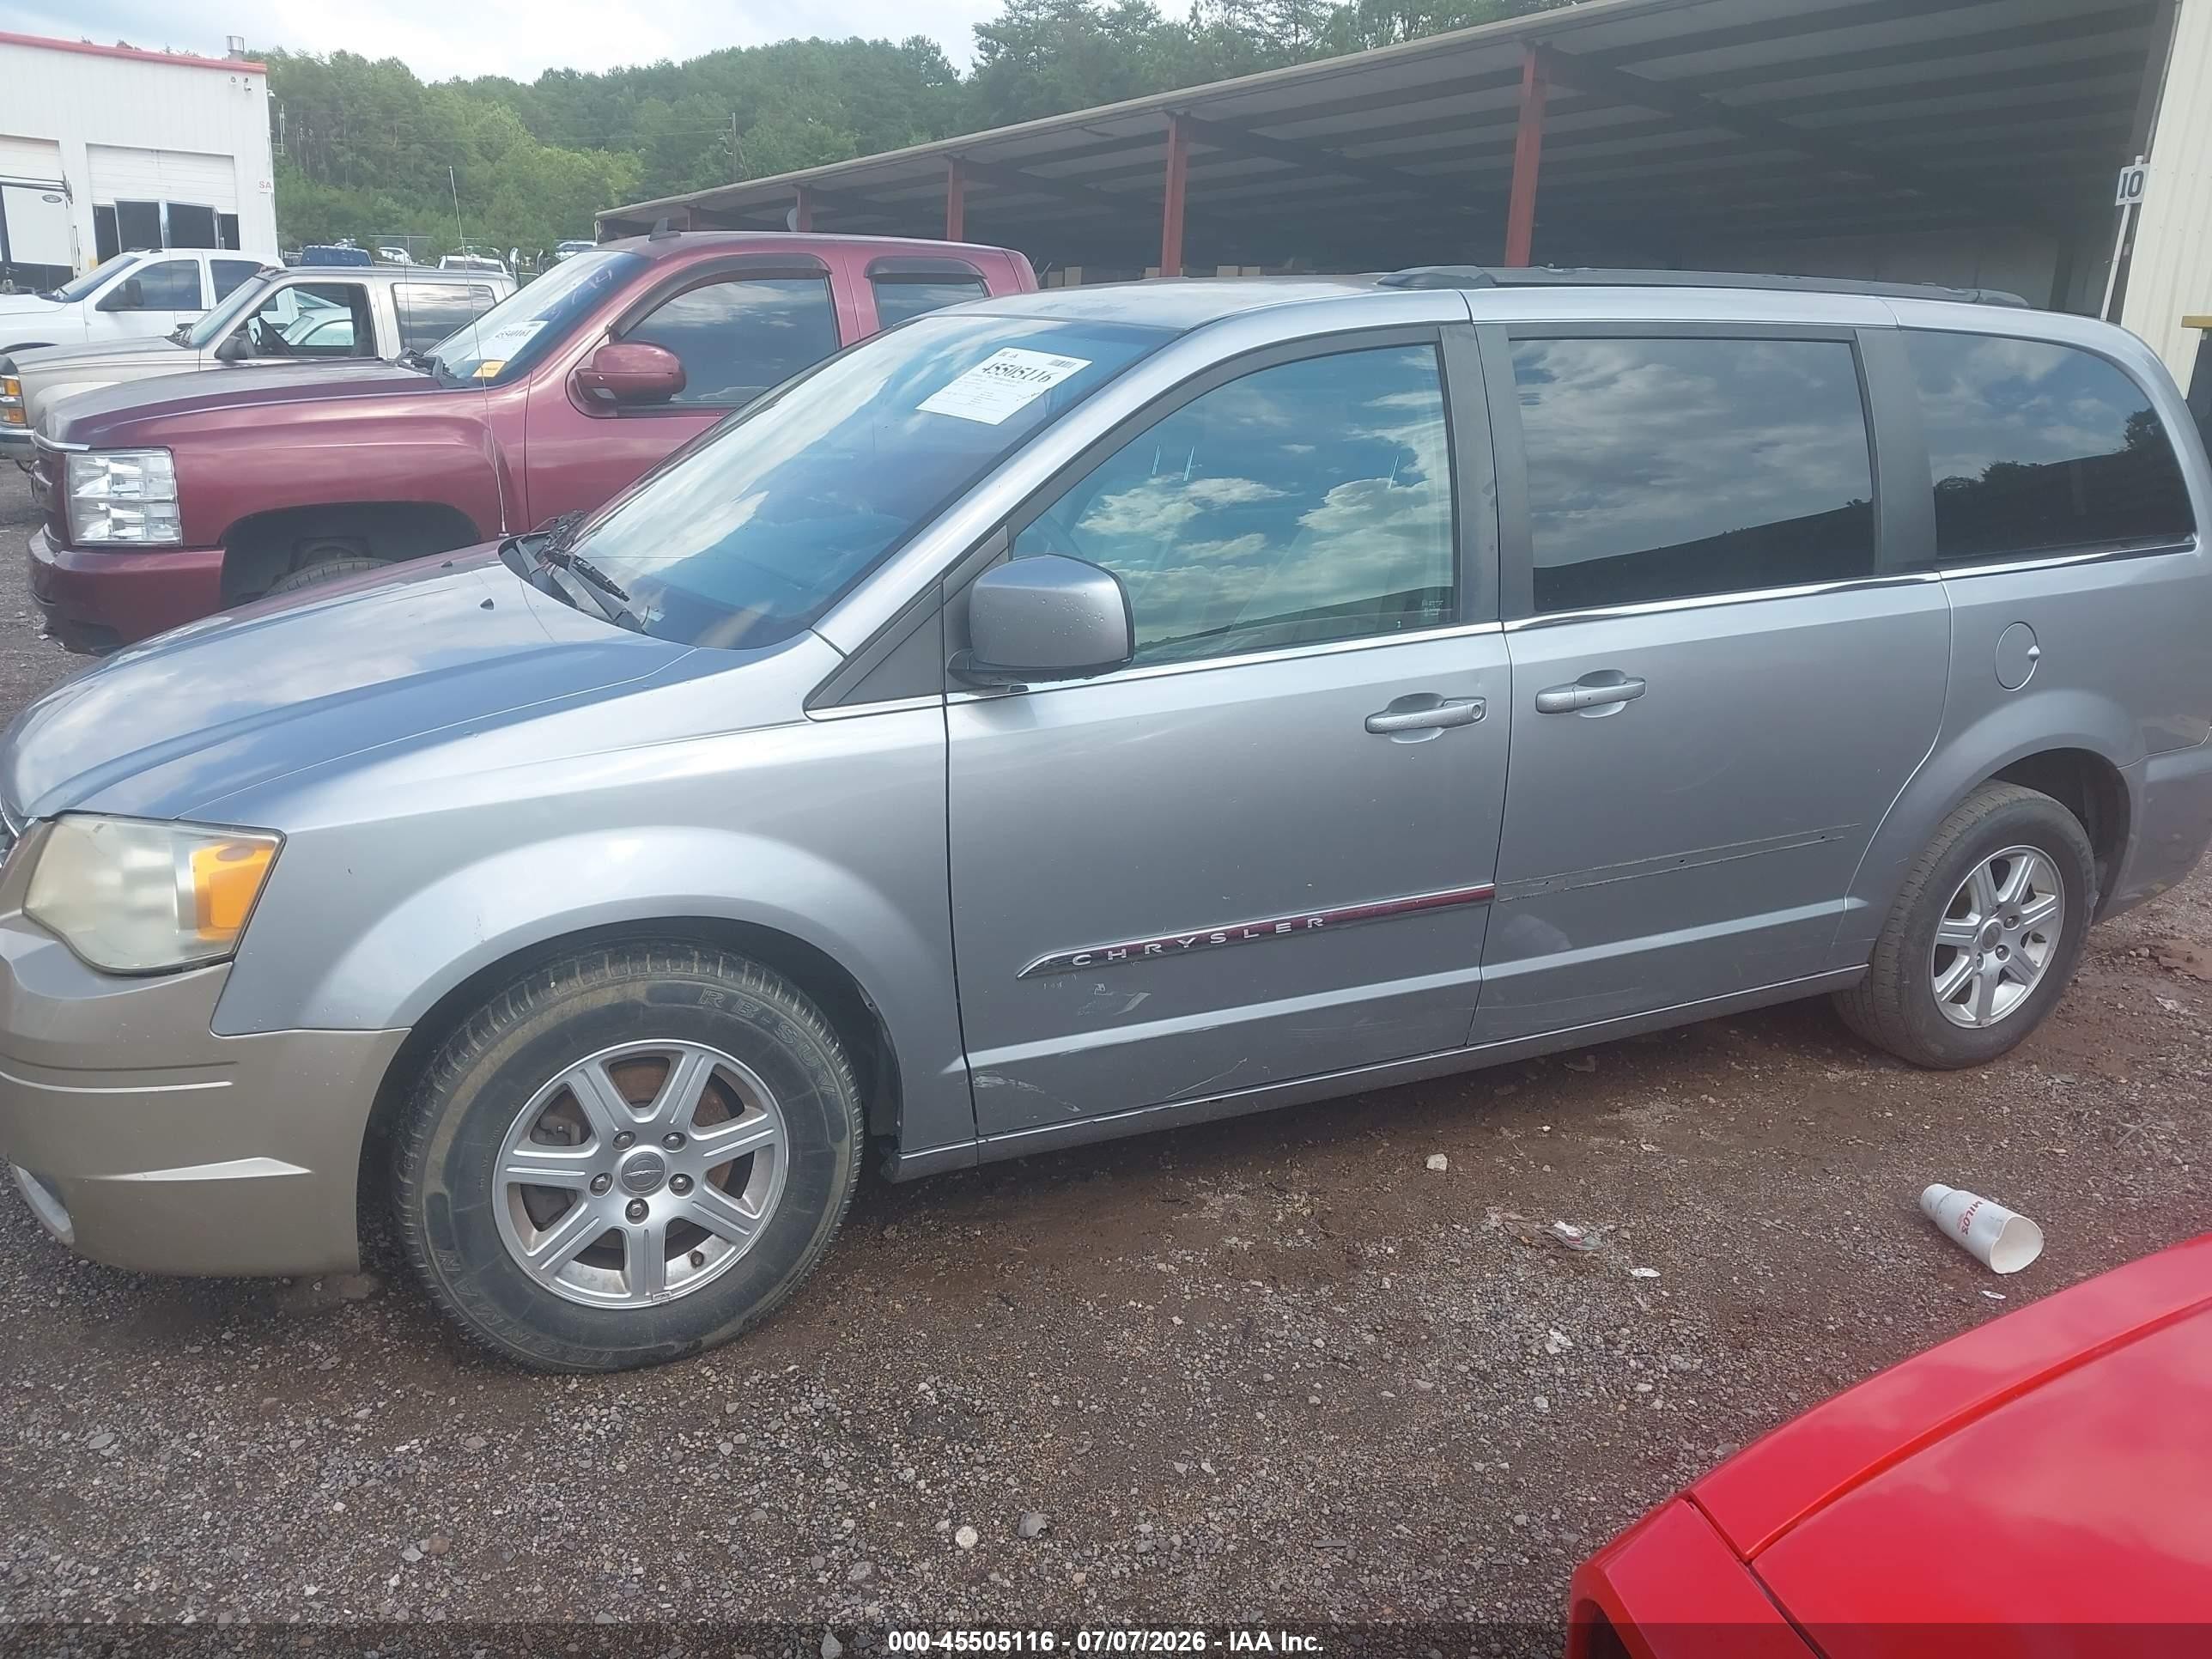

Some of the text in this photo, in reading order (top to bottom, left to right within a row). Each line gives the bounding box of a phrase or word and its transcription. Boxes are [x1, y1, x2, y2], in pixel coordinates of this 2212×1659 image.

[2119, 170, 2144, 198] 10
[982, 362, 1058, 383] 45505116
[1072, 916, 1325, 967] CHRYSLER
